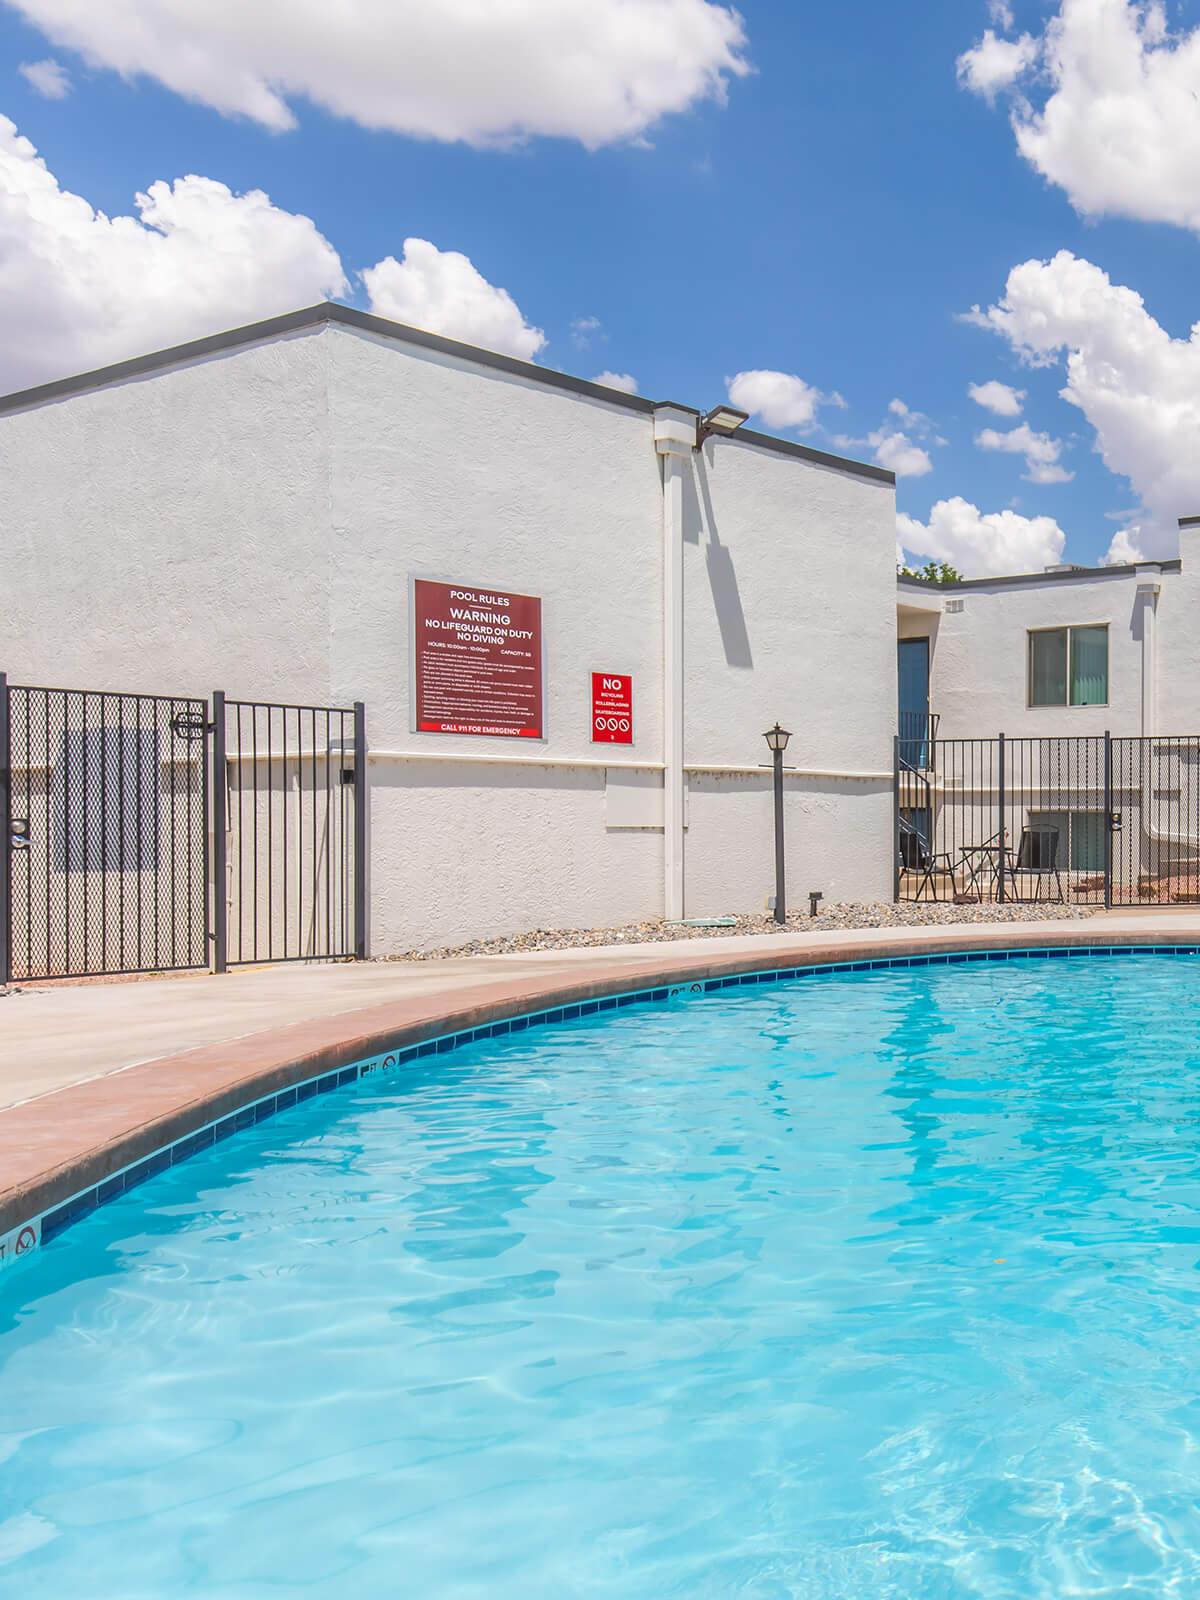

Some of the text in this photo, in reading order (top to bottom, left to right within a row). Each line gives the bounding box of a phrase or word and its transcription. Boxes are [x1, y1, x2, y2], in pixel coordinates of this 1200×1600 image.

[450, 590, 510, 606] POOL RULES
[450, 608, 510, 624] WARNING
[425, 619, 533, 640] NO LIFEGUARD ON DUTY
[457, 632, 505, 645] NO DIVING
[602, 678, 622, 690] NO
[440, 723, 521, 736] CALL 911 FOR EMERGENCY
